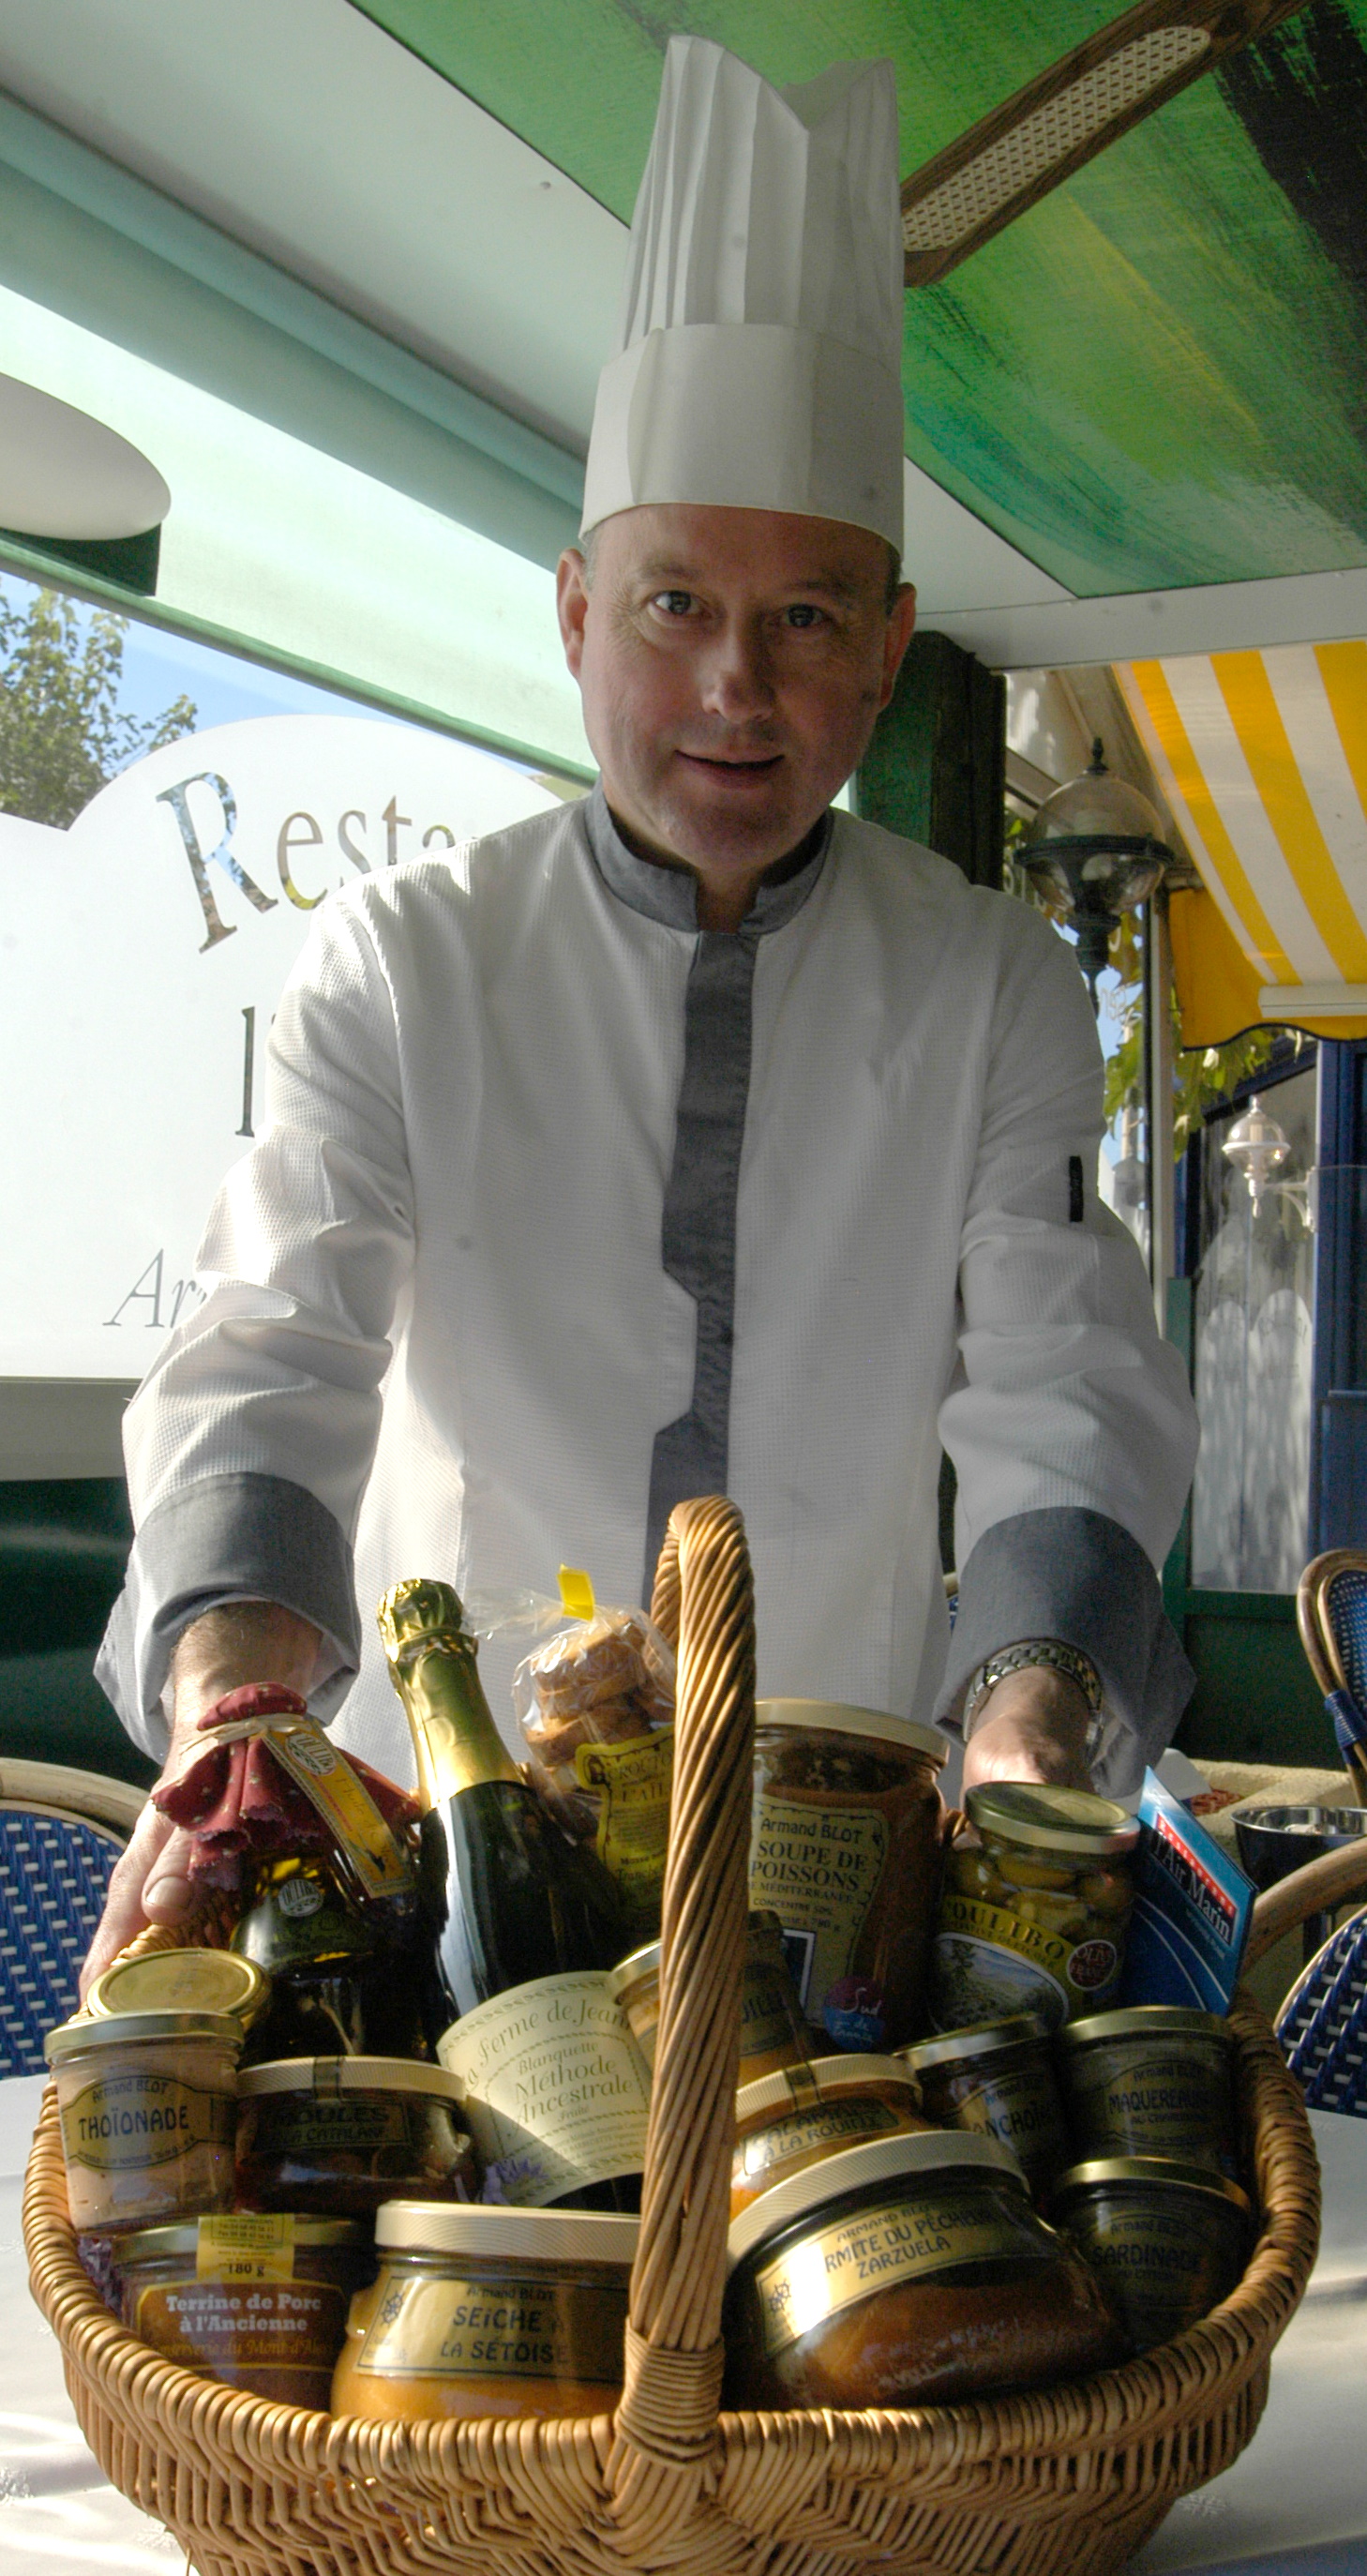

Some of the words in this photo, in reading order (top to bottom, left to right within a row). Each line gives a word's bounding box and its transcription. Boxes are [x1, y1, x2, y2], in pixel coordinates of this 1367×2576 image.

[760, 1817, 818, 1837] Armand
[821, 1824, 863, 1845] BLOT
[758, 1840, 832, 1866] SOUPE
[837, 1850, 868, 1873] DE
[751, 1860, 860, 1891] POISSONS
[477, 2012, 539, 2068] Ferme
[547, 1999, 573, 2024] de
[518, 2041, 599, 2075] Blanquette
[516, 2055, 617, 2105] Méthode
[515, 2073, 634, 2125] Ancestrale
[885, 2223, 912, 2247] DU
[858, 2234, 952, 2280] ZARZUELA
[166, 2293, 242, 2312] Terrine
[247, 2293, 273, 2312] de
[278, 2293, 323, 2312] Porc
[179, 2315, 192, 2334] à
[196, 2314, 308, 2333] l'Ancienne
[440, 2341, 463, 2359] LA
